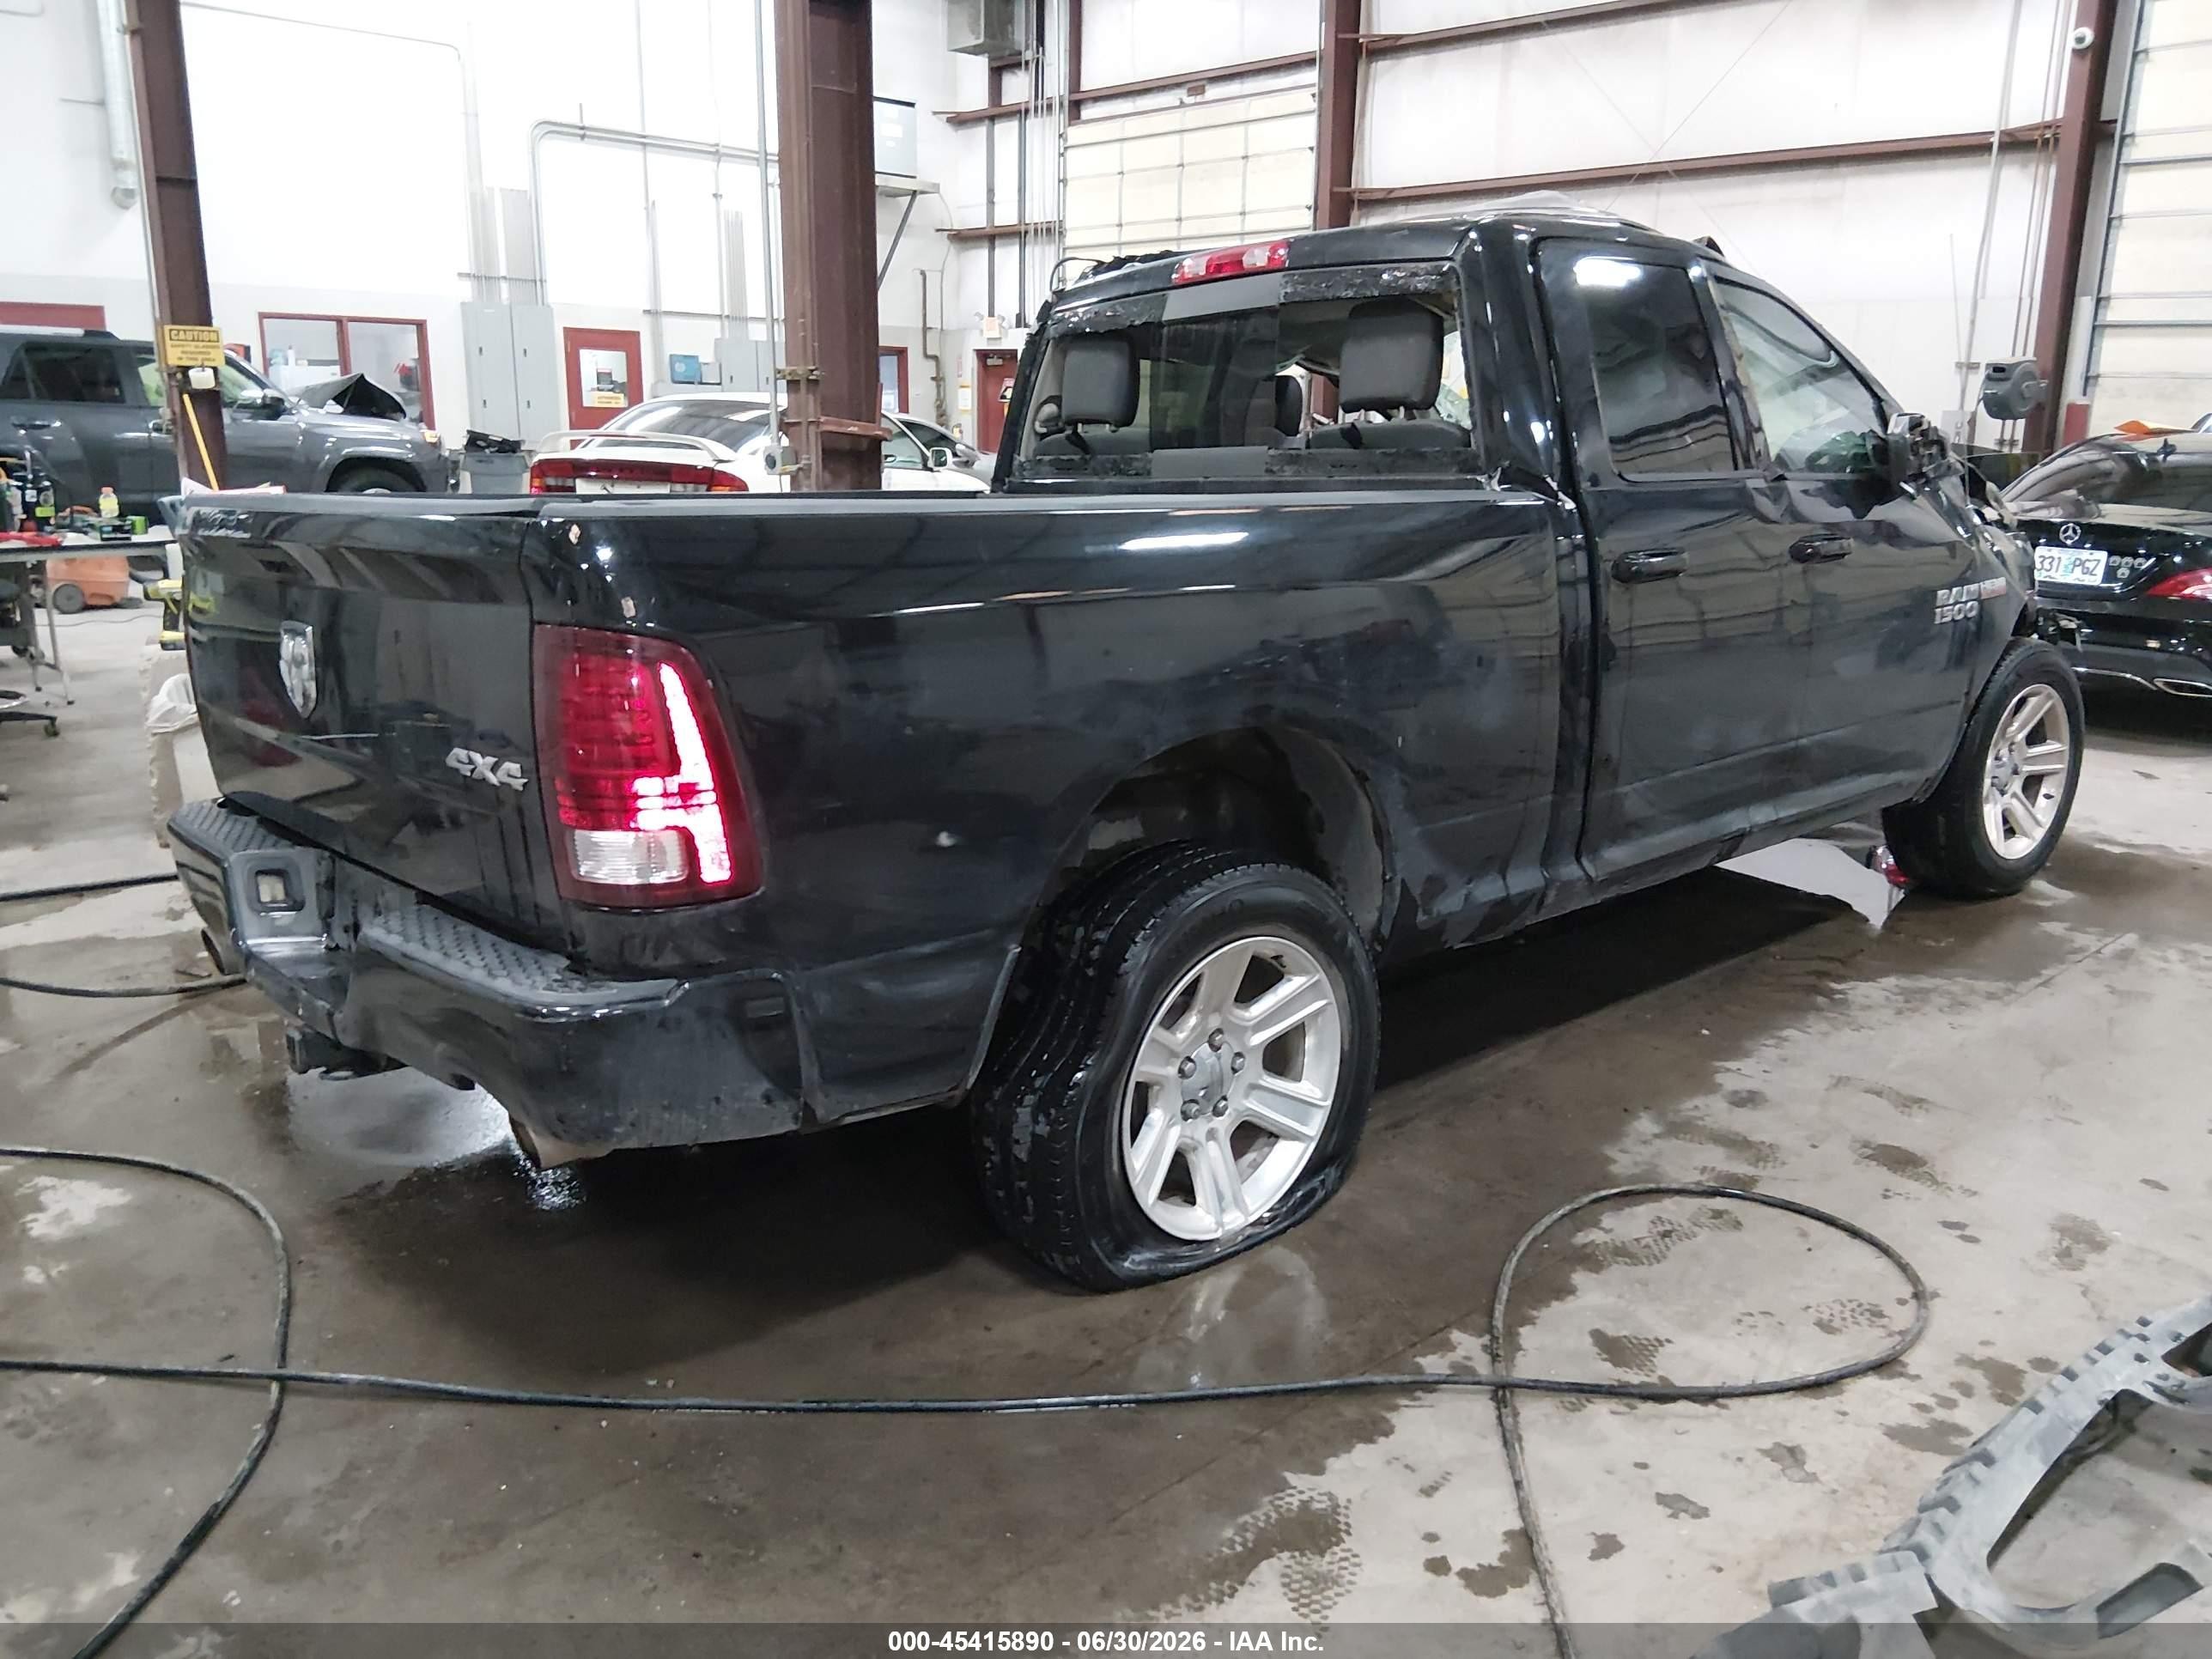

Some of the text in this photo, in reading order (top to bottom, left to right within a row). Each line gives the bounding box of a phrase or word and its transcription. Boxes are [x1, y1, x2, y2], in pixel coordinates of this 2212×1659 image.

[170, 330, 218, 342] CAUTION
[2035, 555, 2062, 574] 331
[1936, 583, 1979, 606] RAM
[1934, 600, 1978, 624] 1500
